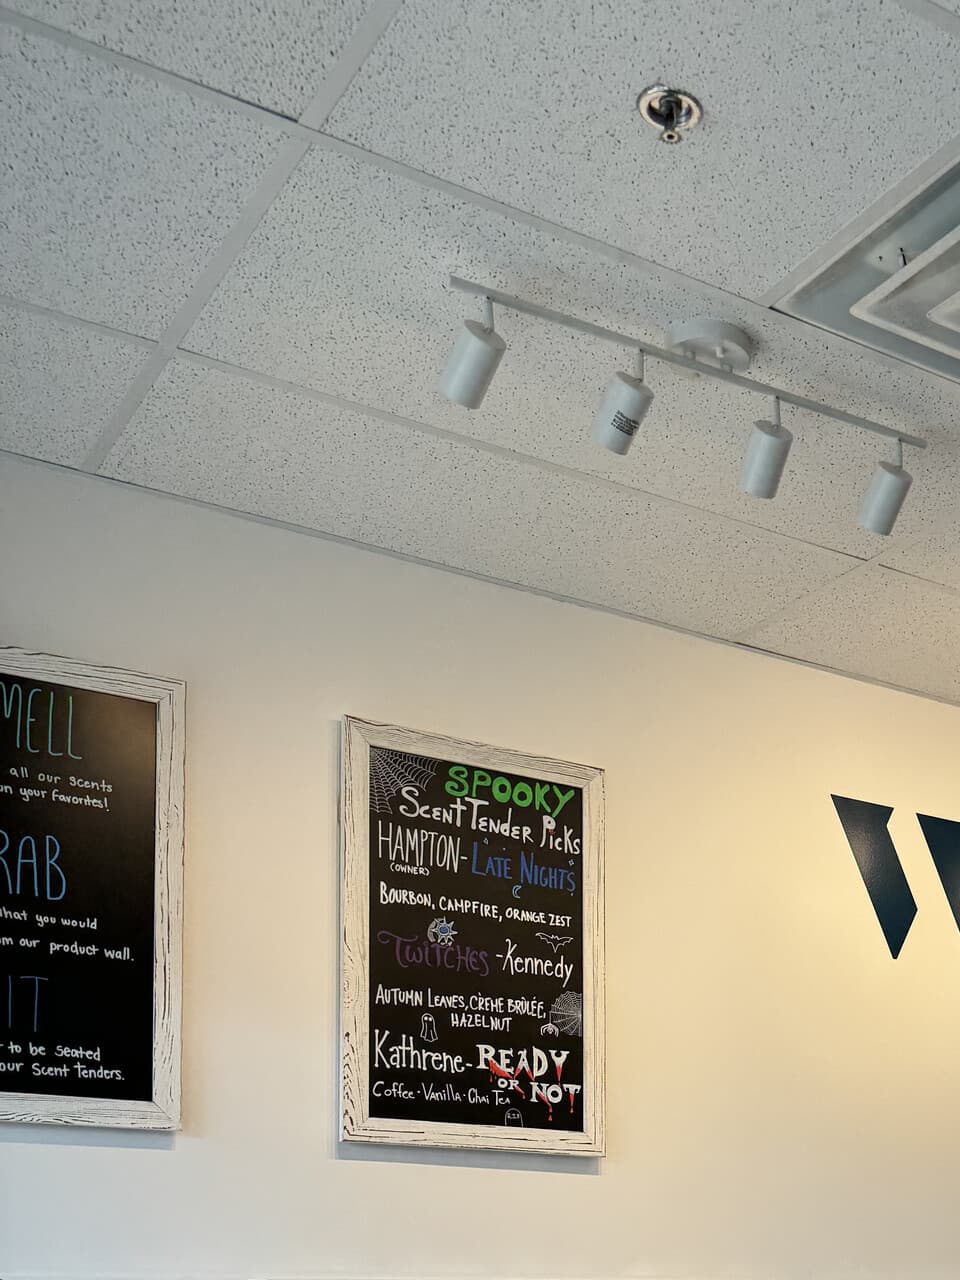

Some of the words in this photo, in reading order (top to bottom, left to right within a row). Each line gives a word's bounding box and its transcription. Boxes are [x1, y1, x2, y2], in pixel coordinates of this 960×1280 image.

[10, 767, 29, 778] all
[38, 772, 62, 785] our
[69, 775, 113, 793] scents
[445, 766, 575, 817] SPOOKY
[19, 787, 47, 802] your
[389, 862, 431, 877] (OWNER)
[471, 841, 513, 880] LATE
[520, 851, 576, 893] NIGHTS
[379, 881, 435, 910] BOURBON,
[439, 896, 502, 922] CAMPFIRE,
[505, 907, 546, 924] ORANGE
[548, 913, 572, 928] ZEST
[35, 914, 57, 927] you
[61, 917, 98, 930] would
[19, 937, 41, 948] our
[49, 941, 100, 956] product
[104, 947, 135, 962] wall.
[375, 984, 423, 1007] AUTUMN
[427, 987, 468, 1011] LEAVES,
[451, 1013, 513, 1032] HAZELNUT
[7, 1041, 22, 1054] to
[29, 1042, 46, 1056] be
[54, 1044, 101, 1062] seated
[476, 1044, 570, 1082] READY
[31, 1062, 70, 1077] Scent
[73, 1061, 125, 1081] Tenders.
[372, 1081, 416, 1099] Coffee
[468, 1088, 490, 1105] Chai
[491, 1089, 511, 1105] Tea
[497, 1078, 520, 1092] OR
[530, 1081, 581, 1108] NOT
